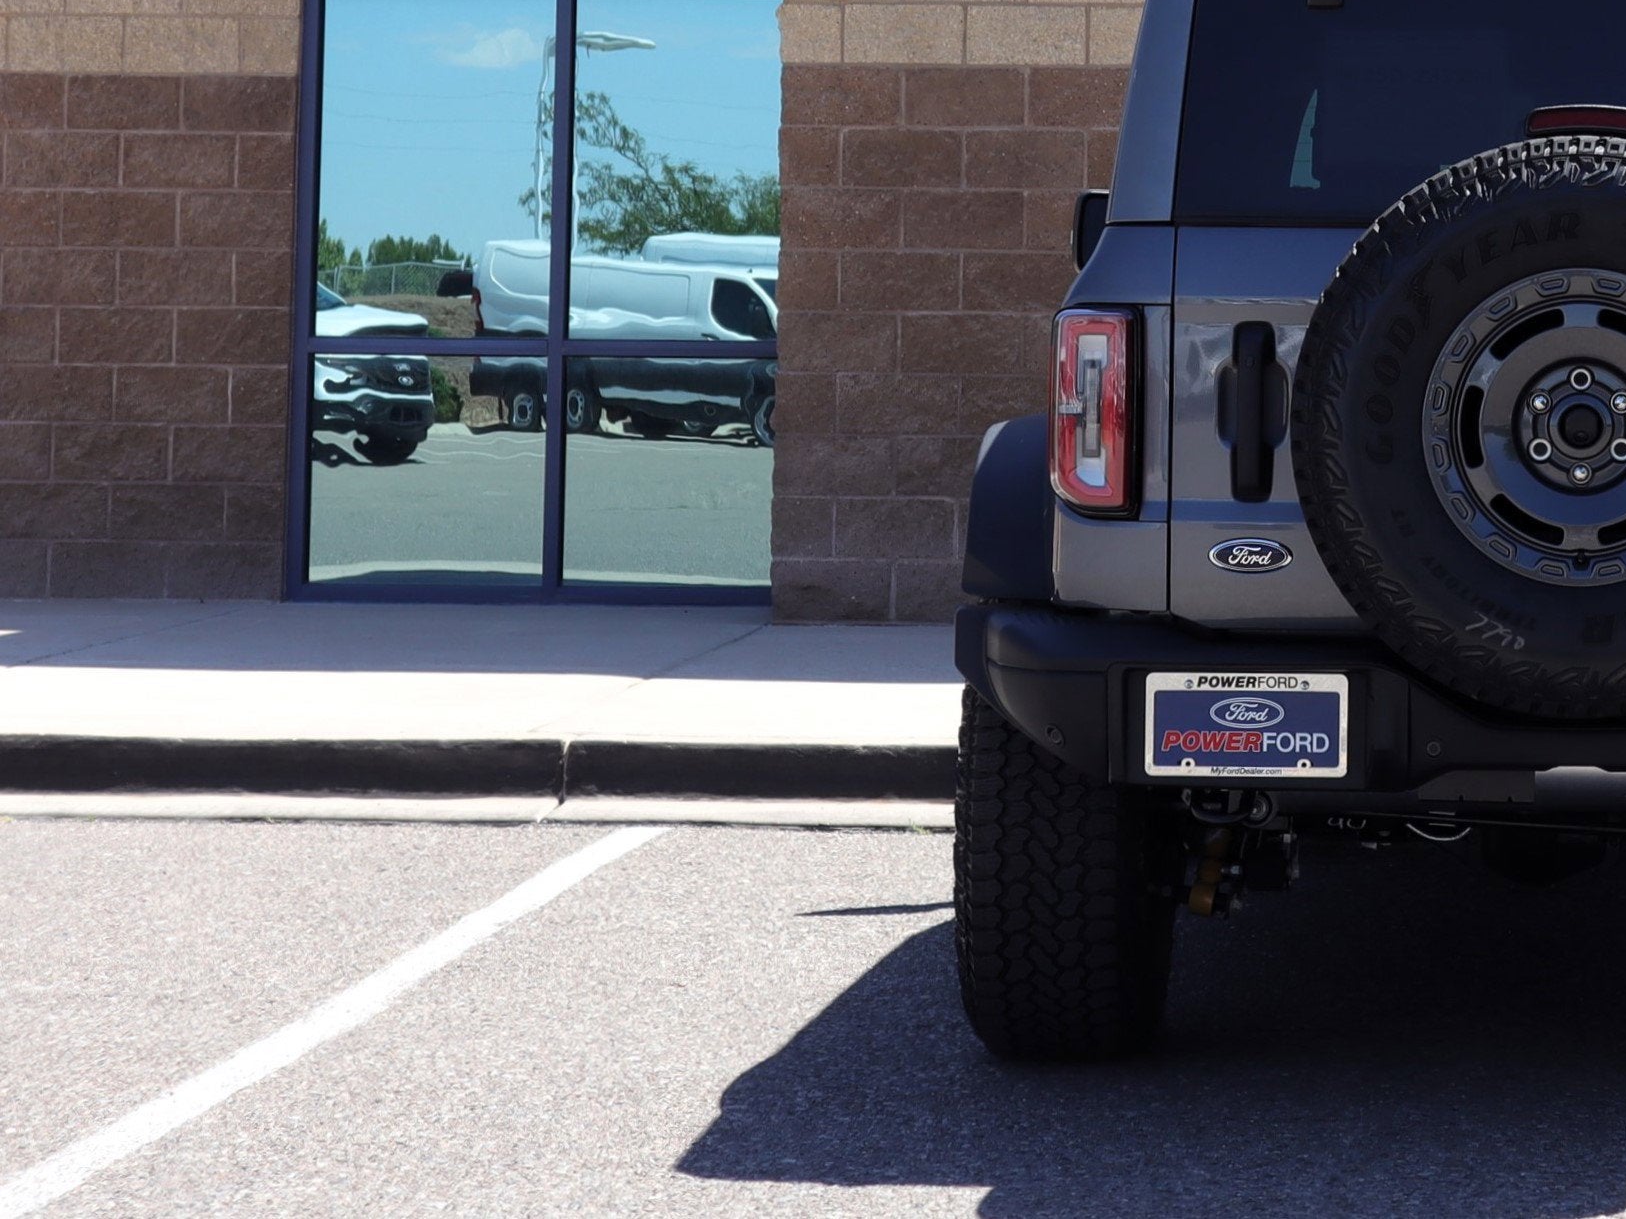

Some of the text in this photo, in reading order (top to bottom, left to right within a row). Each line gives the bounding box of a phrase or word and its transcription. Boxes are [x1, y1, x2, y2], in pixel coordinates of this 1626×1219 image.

[1228, 544, 1271, 567] Ford
[1196, 675, 1299, 689] POWERFORD
[1225, 701, 1269, 723] Ford
[1161, 730, 1330, 754] POWERFORD
[1210, 766, 1283, 776] MyFordDealer.com
